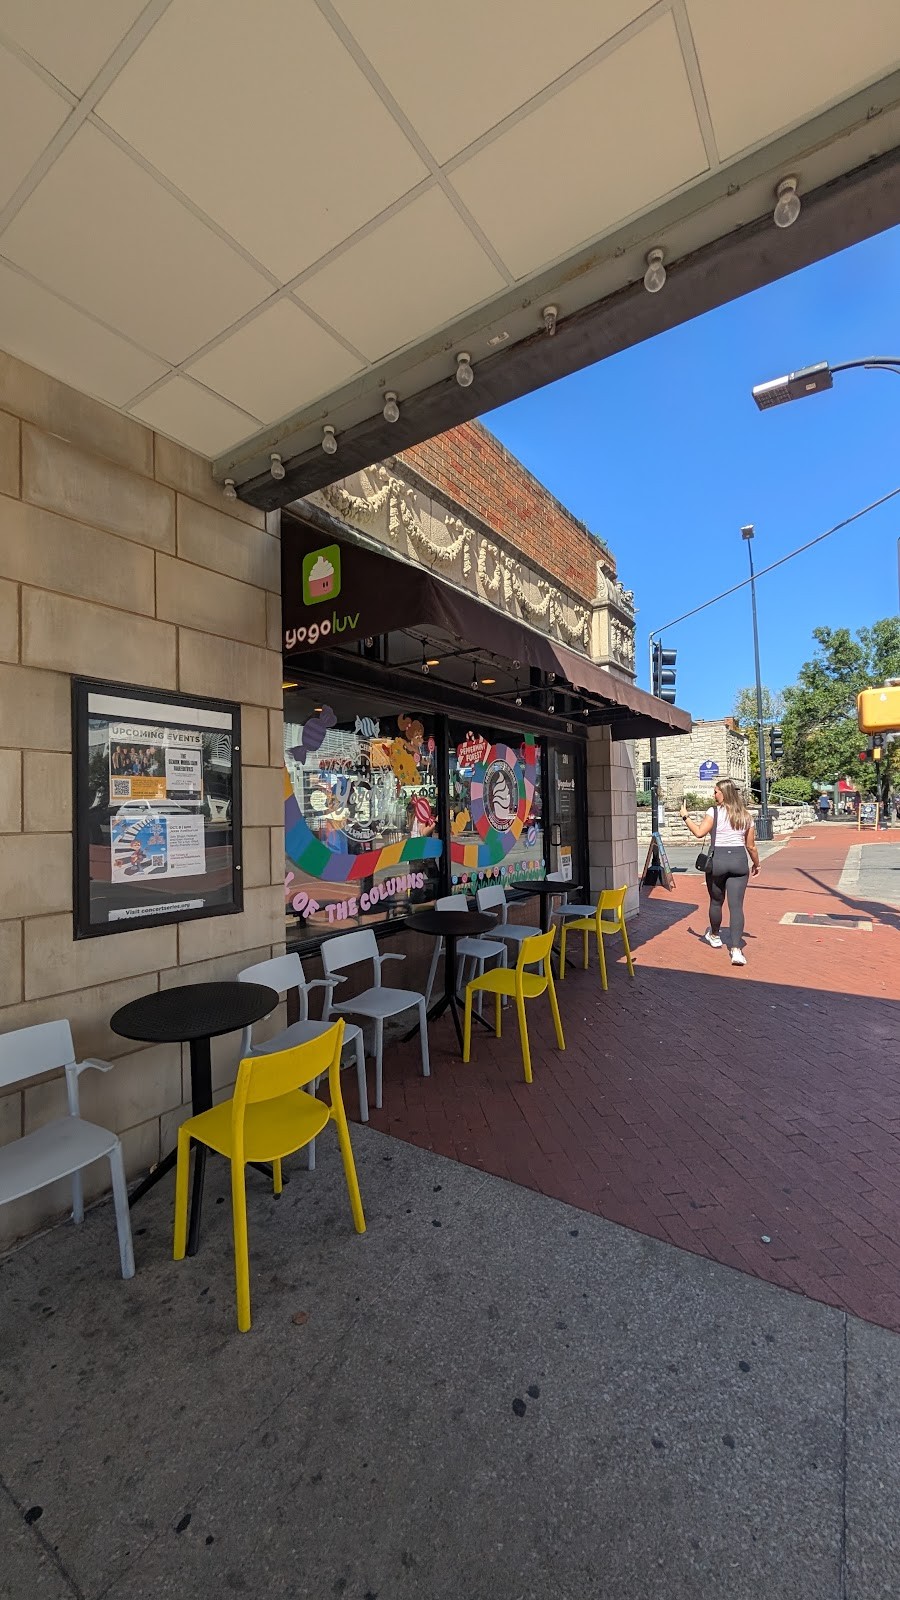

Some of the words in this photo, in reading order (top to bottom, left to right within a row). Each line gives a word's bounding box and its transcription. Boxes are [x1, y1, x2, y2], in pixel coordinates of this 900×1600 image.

[285, 611, 360, 649] yogoluv
[112, 727, 164, 740] UPCOMING
[167, 733, 201, 743] EVENTS
[460, 743, 486, 756] PEPPERMINT
[466, 751, 482, 763] FOREST
[292, 891, 320, 919] OF
[325, 897, 359, 923] THE
[360, 872, 424, 911] COLUMNS
